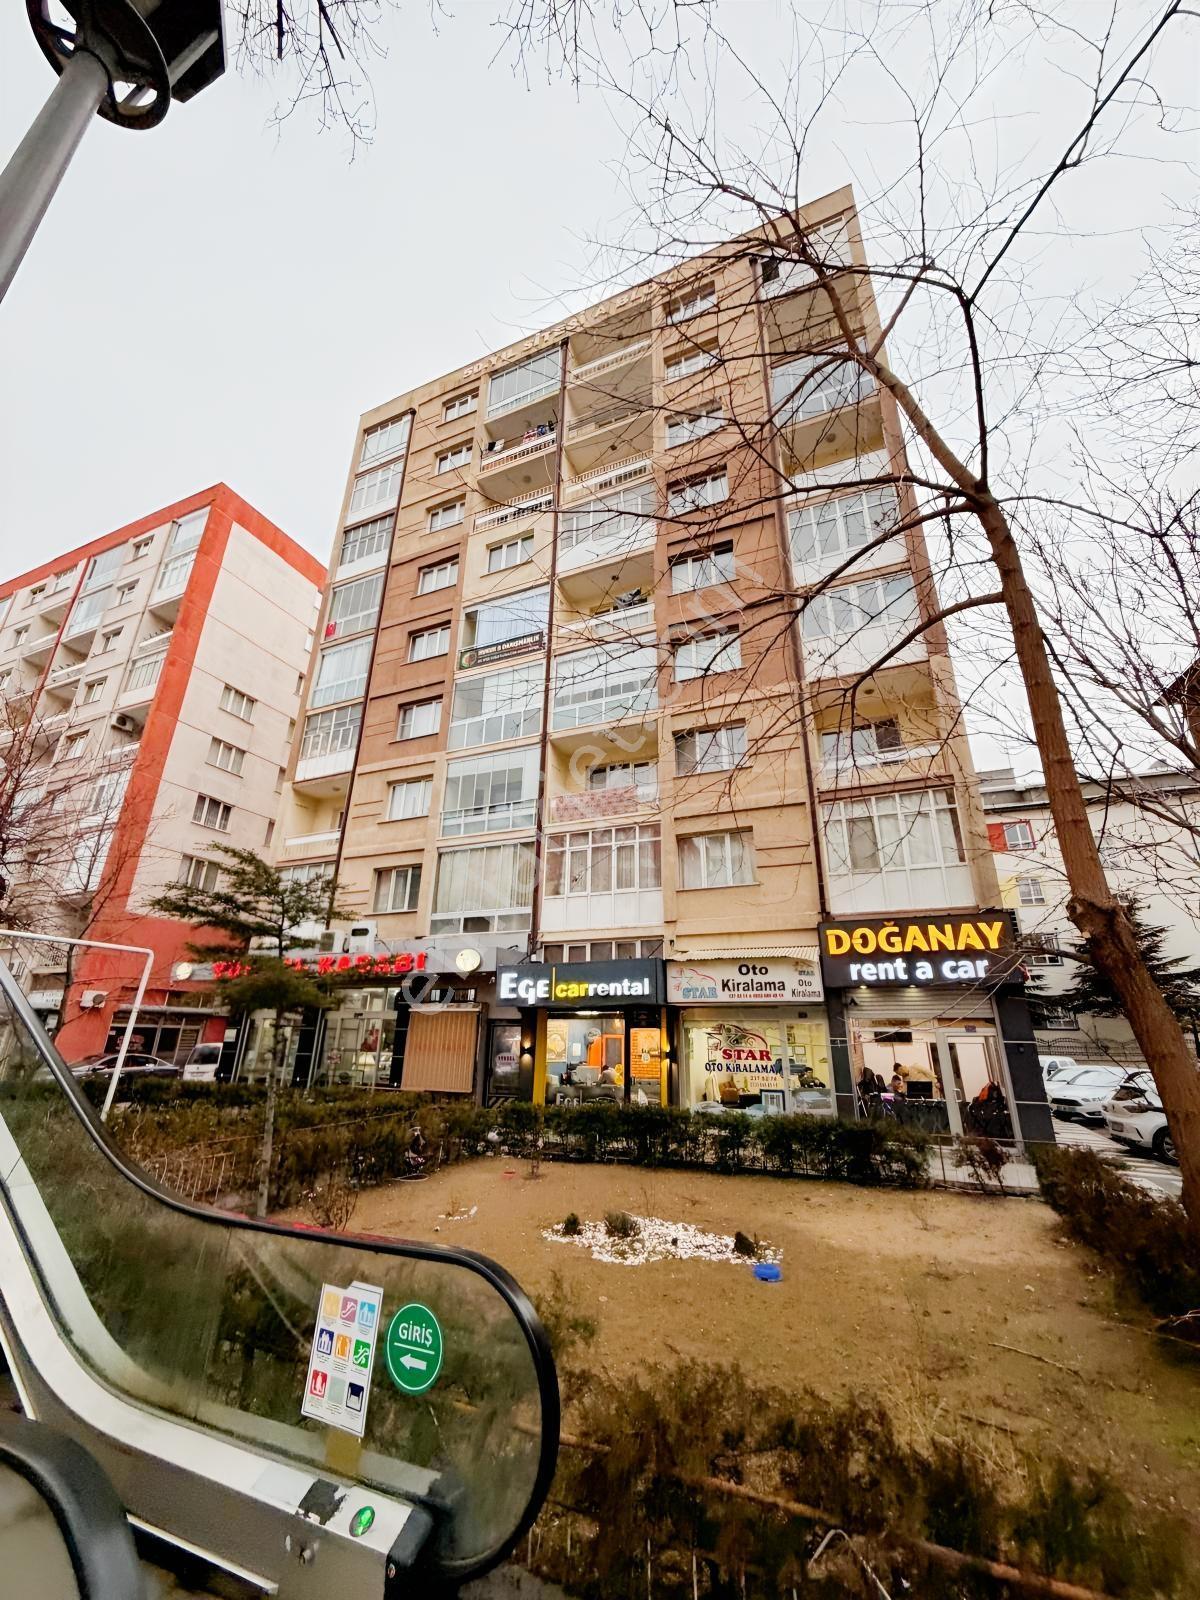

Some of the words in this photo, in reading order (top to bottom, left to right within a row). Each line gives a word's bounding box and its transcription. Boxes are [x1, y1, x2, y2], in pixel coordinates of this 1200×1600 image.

[825, 921, 1004, 955] DOĞANAY
[738, 964, 769, 976] Oto
[850, 958, 908, 981] rent
[915, 961, 934, 980] a
[942, 959, 989, 979] car
[500, 972, 550, 1005] EGE
[721, 979, 786, 993] Kiralama
[798, 979, 812, 987] Oto
[682, 986, 719, 999] STAR
[791, 988, 822, 998] Kiralama
[722, 1049, 772, 1061] STAR
[705, 1062, 723, 1073] OTO
[398, 1322, 433, 1348] GİRİŞ
